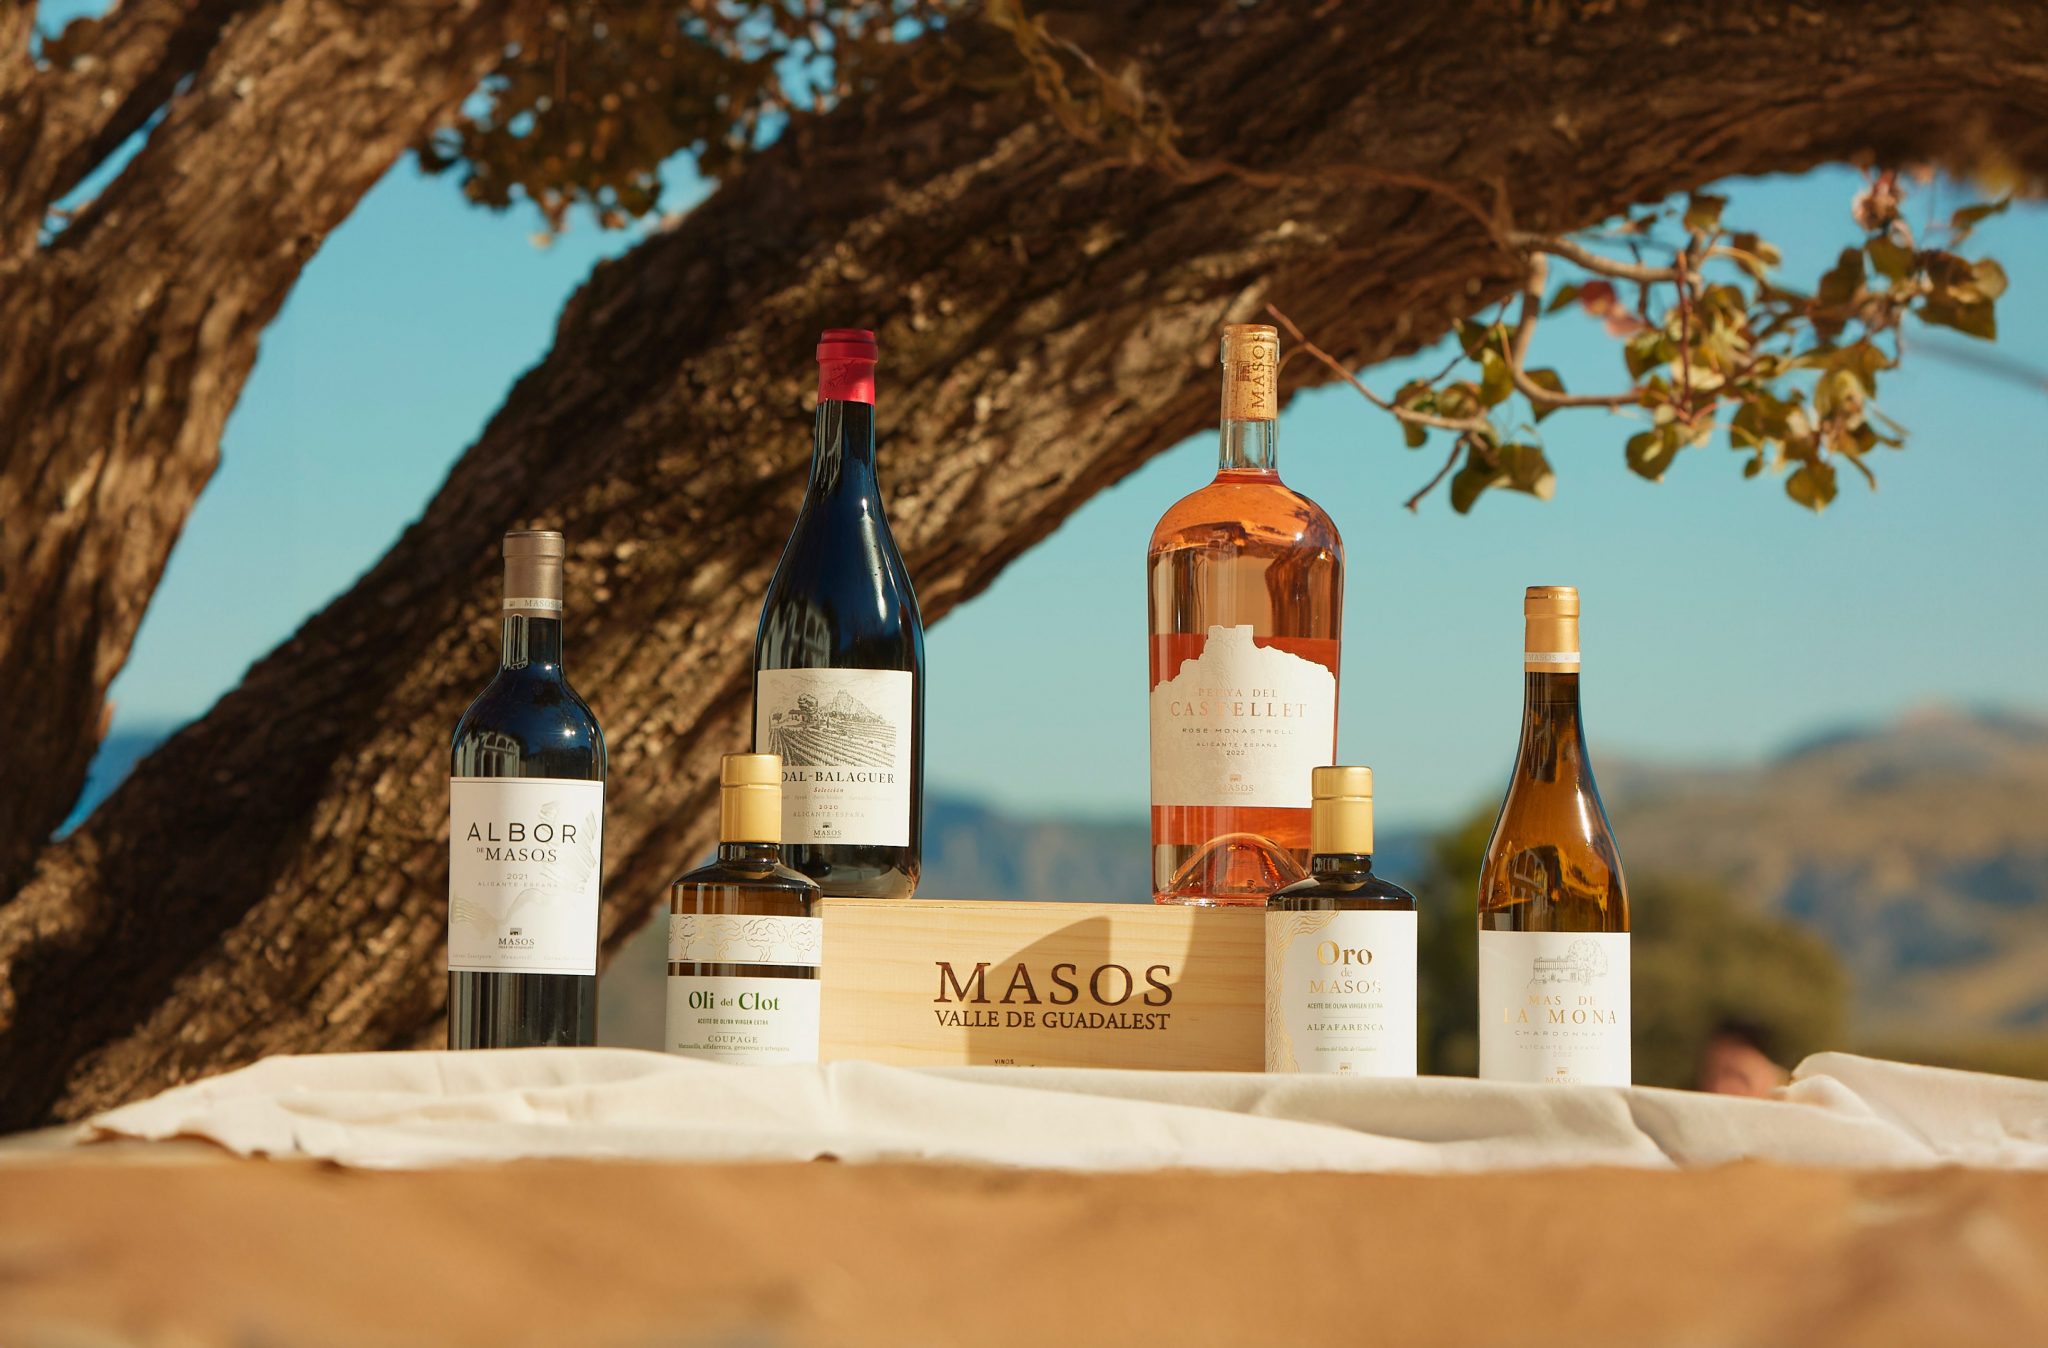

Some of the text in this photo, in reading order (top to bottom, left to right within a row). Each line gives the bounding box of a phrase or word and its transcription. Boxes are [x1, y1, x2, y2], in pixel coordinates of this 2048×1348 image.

[1252, 689, 1279, 698] DEL
[781, 771, 895, 784] DAL-BALAGUER
[466, 821, 577, 844] ALBOR
[485, 847, 558, 863] MASOS
[498, 937, 536, 946] MASOS
[1316, 940, 1373, 966] Oro
[1340, 967, 1353, 978] de
[933, 961, 1173, 1007] MASOS
[1308, 979, 1381, 994] MASOS
[688, 990, 781, 1011] Oli del Clot
[934, 1009, 1171, 1030] VALLE DE GUADALEST
[1548, 1008, 1617, 1024] MONA
[1306, 1023, 1384, 1031] ALFAFARENCA
[707, 1034, 759, 1044] COUPAGE
